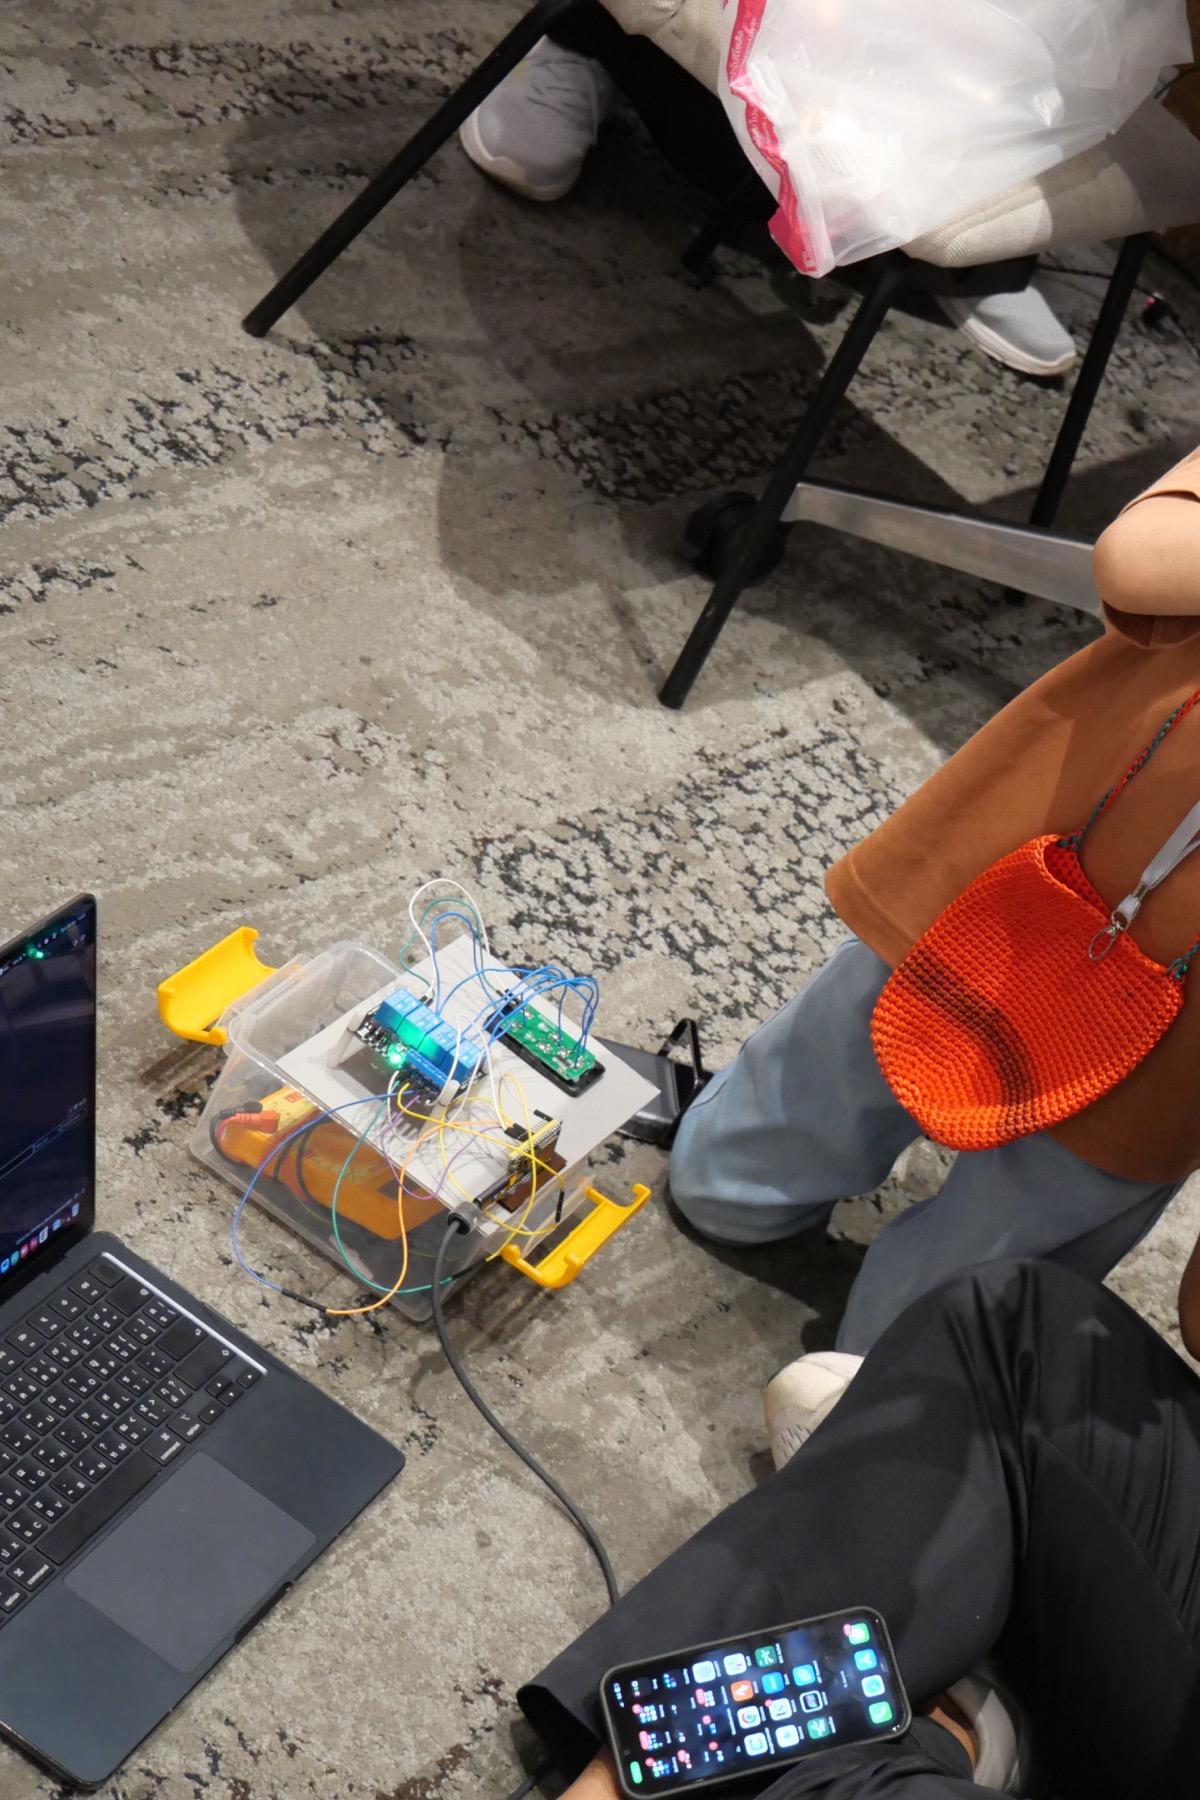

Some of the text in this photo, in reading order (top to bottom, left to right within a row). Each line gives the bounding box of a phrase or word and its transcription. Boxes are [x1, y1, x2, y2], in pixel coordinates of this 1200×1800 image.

[186, 1423, 200, 1436] option
[160, 1440, 180, 1460] command
[26, 1563, 49, 1585] command
[4, 1591, 21, 1607] option
